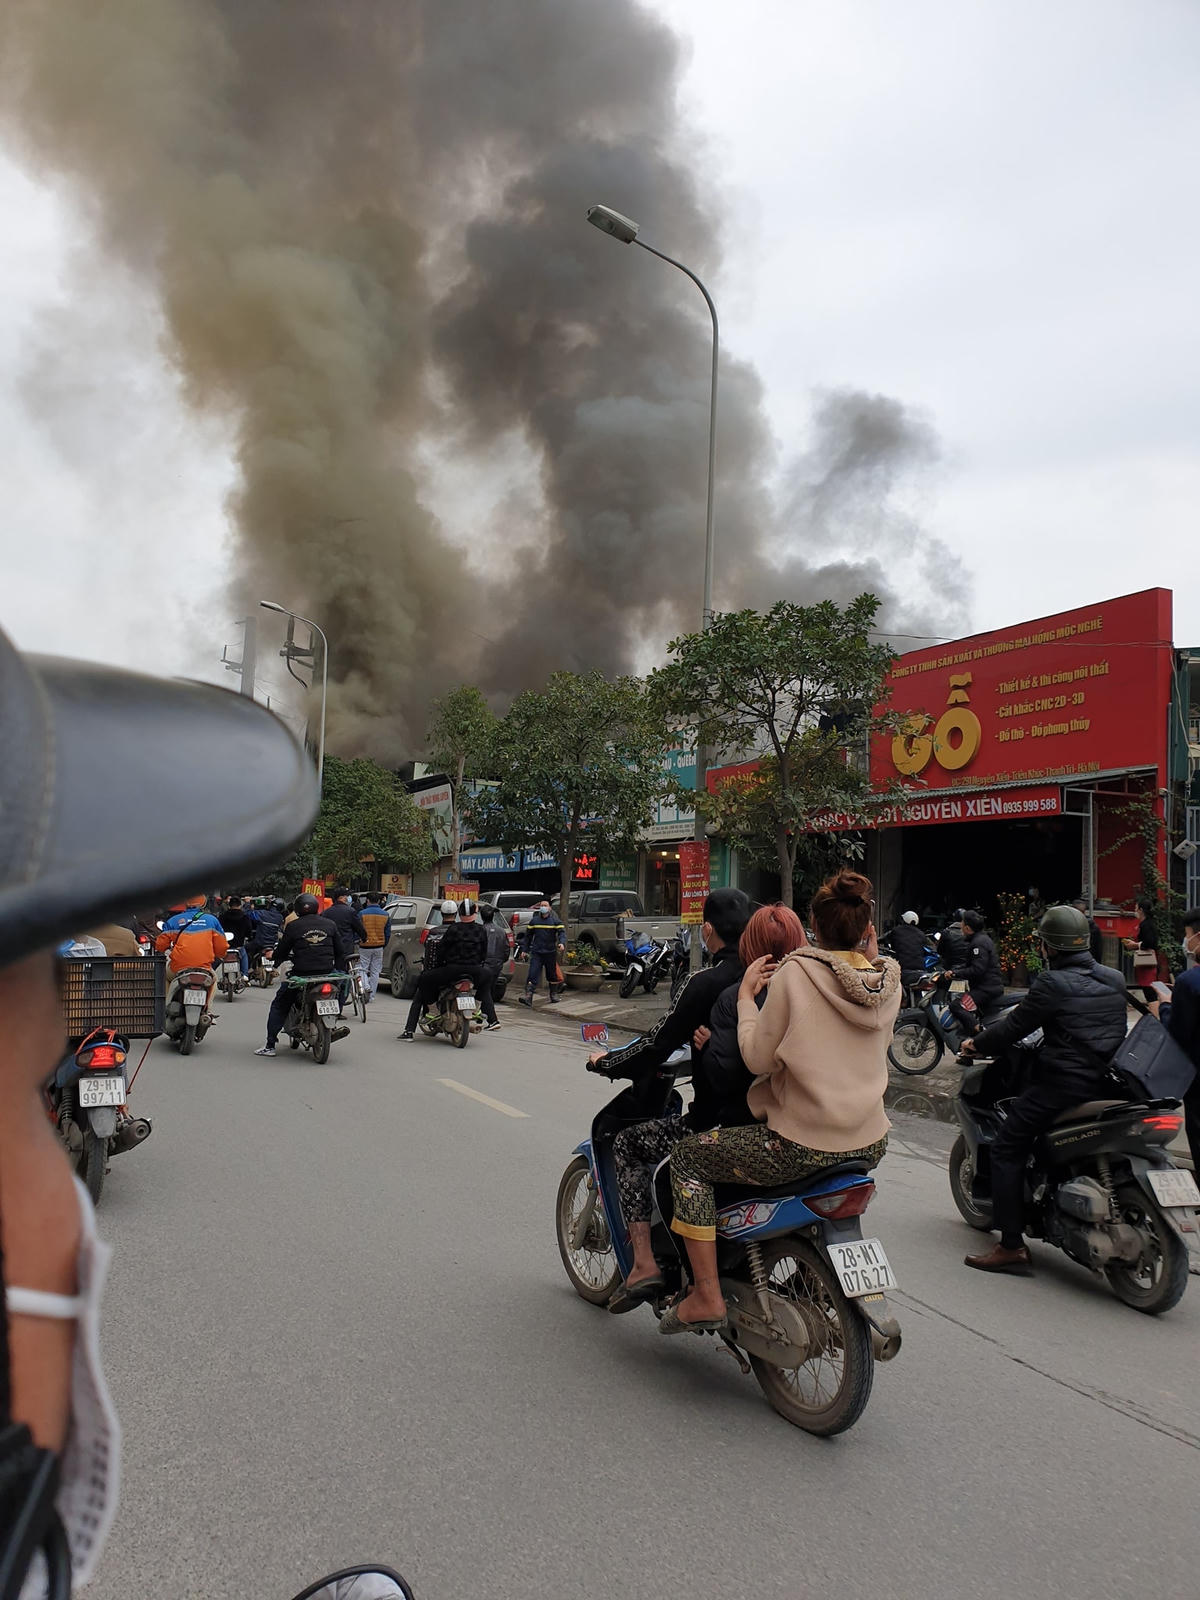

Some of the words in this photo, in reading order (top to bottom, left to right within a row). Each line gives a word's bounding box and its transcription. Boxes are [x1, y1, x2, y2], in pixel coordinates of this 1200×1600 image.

[892, 667, 909, 679] CÔNG
[910, 664, 918, 675] TY
[954, 649, 973, 665] XUẤT
[1056, 624, 1076, 640] MỘC
[1077, 616, 1103, 633] NGHỆ
[1032, 677, 1039, 688] &
[1035, 698, 1054, 712] CNC
[1055, 695, 1067, 709] 2D
[1072, 692, 1085, 705] 3D
[1043, 722, 1069, 737] phong
[677, 754, 697, 768] QUEEN
[1003, 801, 1022, 814] 0935
[1023, 800, 1038, 811] 999
[1041, 798, 1057, 810] 588
[462, 857, 475, 869] MÁY
[478, 857, 496, 872] LẠNH
[305, 881, 322, 896] RỬA
[87, 1080, 117, 1091] 29-H1
[83, 1092, 121, 1104] 997.11
[838, 1243, 879, 1269] 28-N1
[843, 1265, 890, 1293] 076.27
